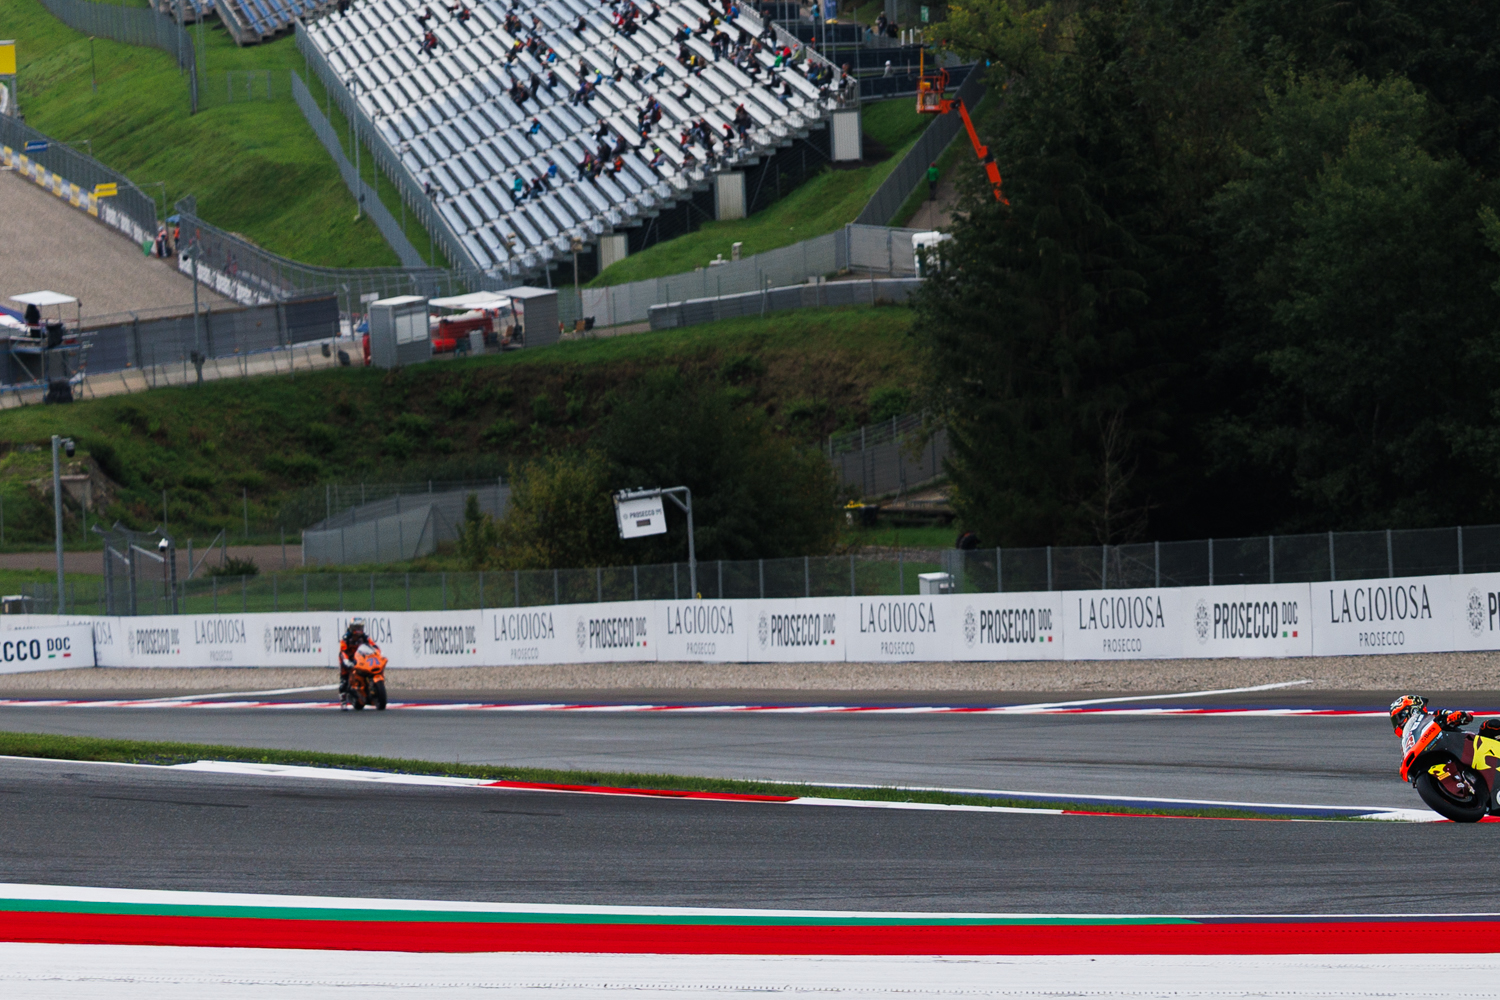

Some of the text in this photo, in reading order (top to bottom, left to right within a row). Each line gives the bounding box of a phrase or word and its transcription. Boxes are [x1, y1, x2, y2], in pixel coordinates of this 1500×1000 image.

[588, 615, 635, 649] PROSECCO
[771, 612, 836, 647] PROSECCO DOC
[980, 607, 1053, 644] PROSECCO DOC
[1213, 600, 1299, 640] PROSECCO DOC
[46, 636, 71, 652] DOC
[136, 627, 170, 655] PROSECCO
[273, 624, 311, 654] PROSECCO
[423, 624, 465, 655] PROSECCO
[686, 642, 716, 655] PROSECCO
[880, 641, 915, 655] PROSECCO
[1103, 637, 1142, 653] PROSECCO
[1358, 630, 1405, 647] PROSECCO
[366, 657, 381, 666] 71
